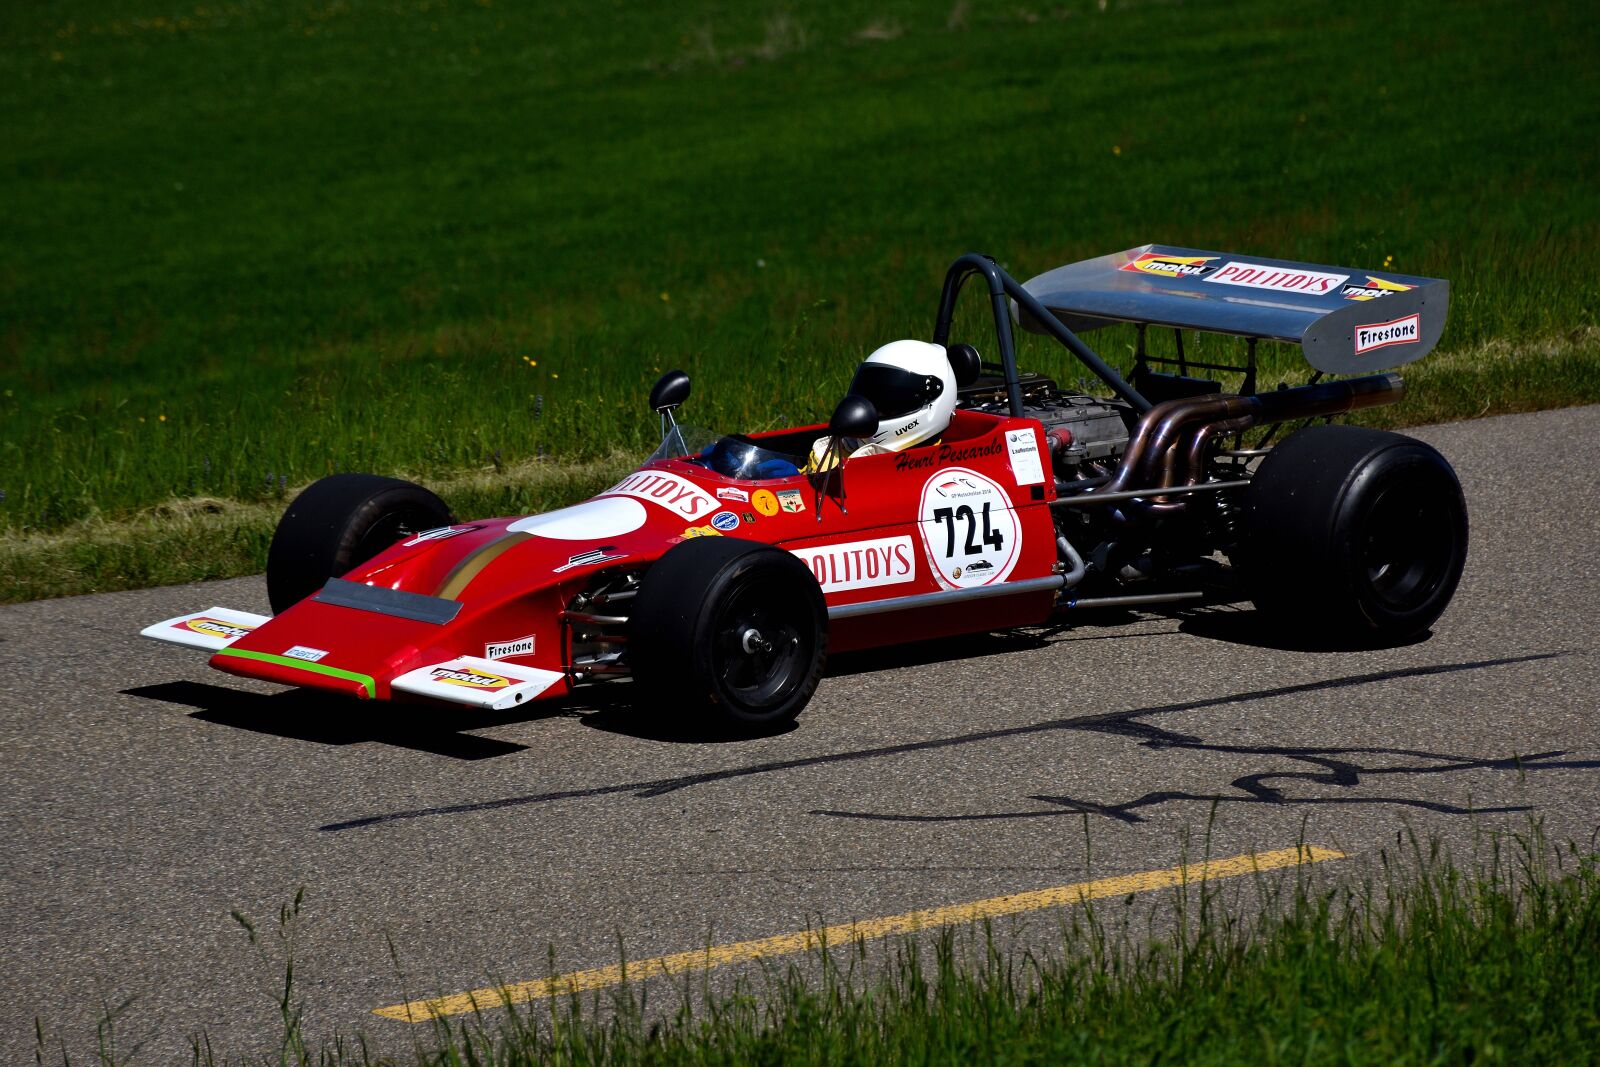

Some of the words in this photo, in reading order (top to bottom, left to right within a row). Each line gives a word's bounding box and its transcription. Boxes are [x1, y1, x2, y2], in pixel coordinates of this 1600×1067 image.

[1144, 262, 1206, 275] motul
[1213, 266, 1338, 292] POLITOYS
[1359, 324, 1415, 347] Firestone
[895, 419, 919, 436] uvex
[894, 452, 935, 472] Henri
[939, 437, 1002, 466] Pescarolo
[934, 502, 1004, 558] 724
[488, 642, 532, 658] Firestone
[431, 669, 500, 686] motul
